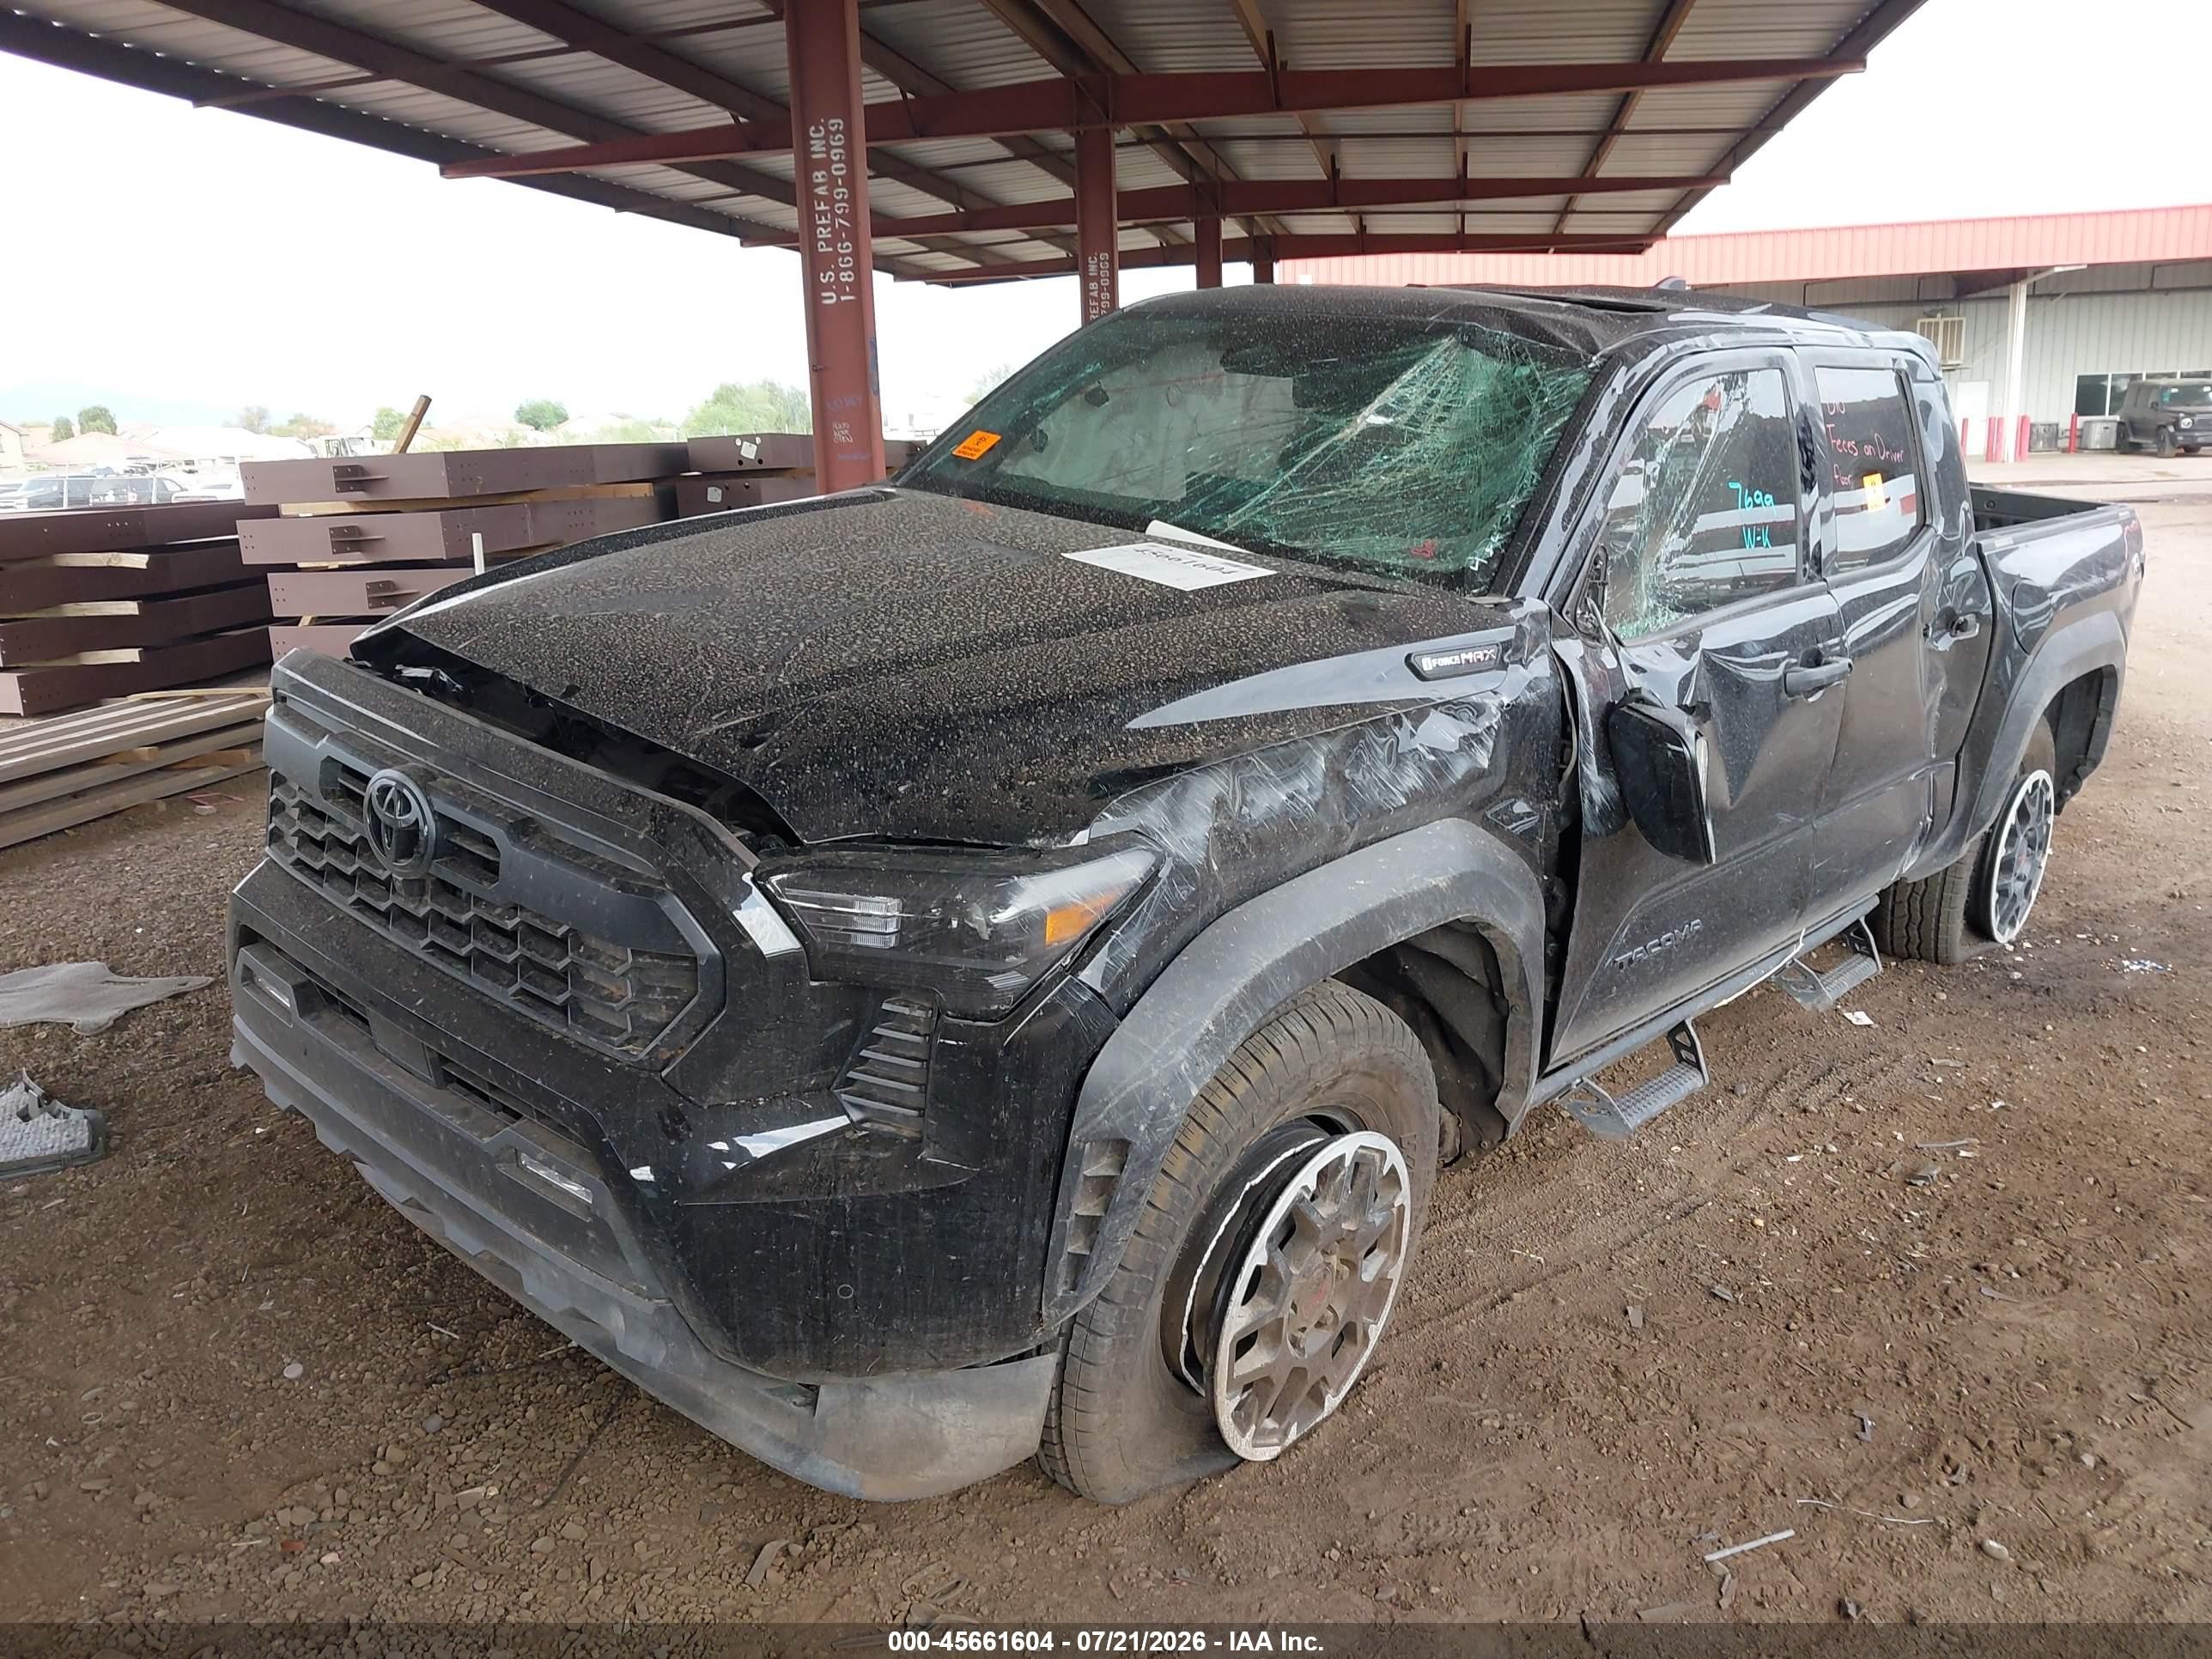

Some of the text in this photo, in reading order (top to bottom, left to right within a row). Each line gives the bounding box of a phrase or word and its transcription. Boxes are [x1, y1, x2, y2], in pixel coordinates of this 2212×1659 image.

[809, 118, 837, 304] U.S. PREFAB INC.
[828, 118, 856, 301] 1-866-799-0969
[1863, 444, 1876, 457] on
[1875, 433, 1905, 463] Driver
